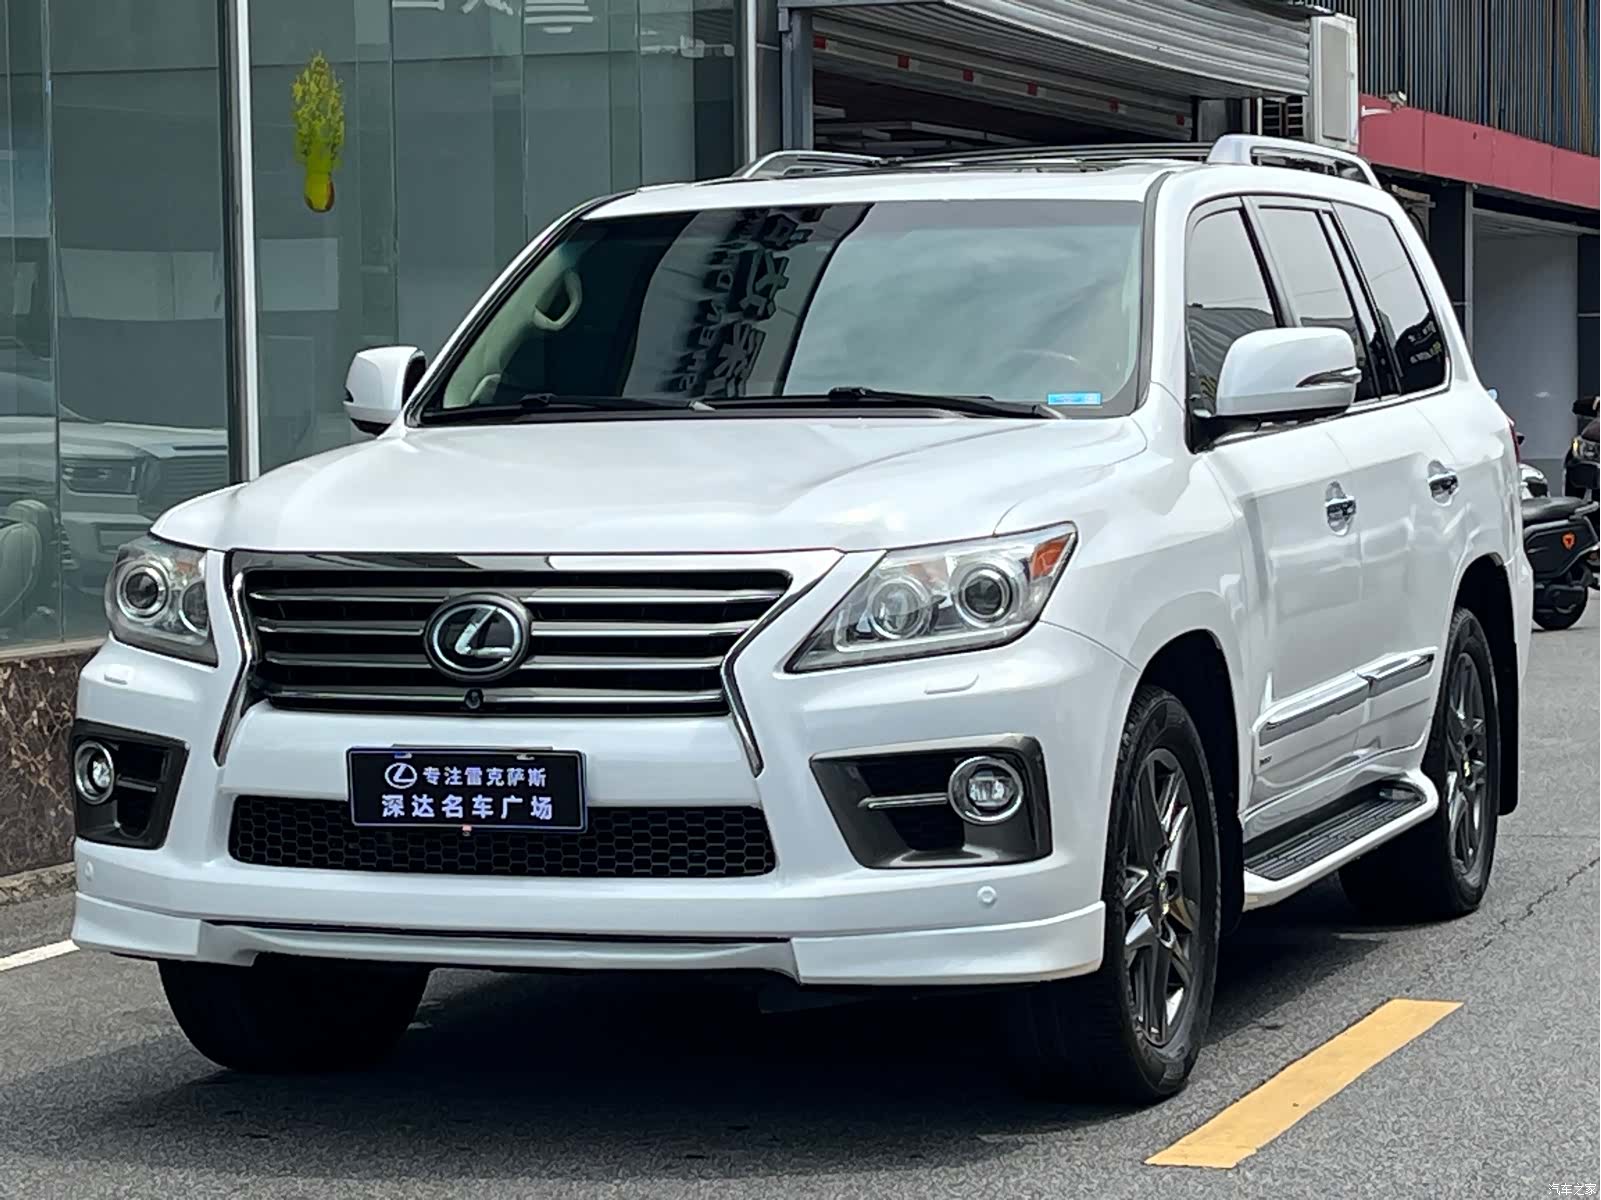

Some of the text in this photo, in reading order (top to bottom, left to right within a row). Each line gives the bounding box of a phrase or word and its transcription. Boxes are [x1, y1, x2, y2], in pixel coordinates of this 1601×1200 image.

[422, 766, 547, 787] 专注雷克萨斯
[381, 794, 553, 820] 深达名车广场
